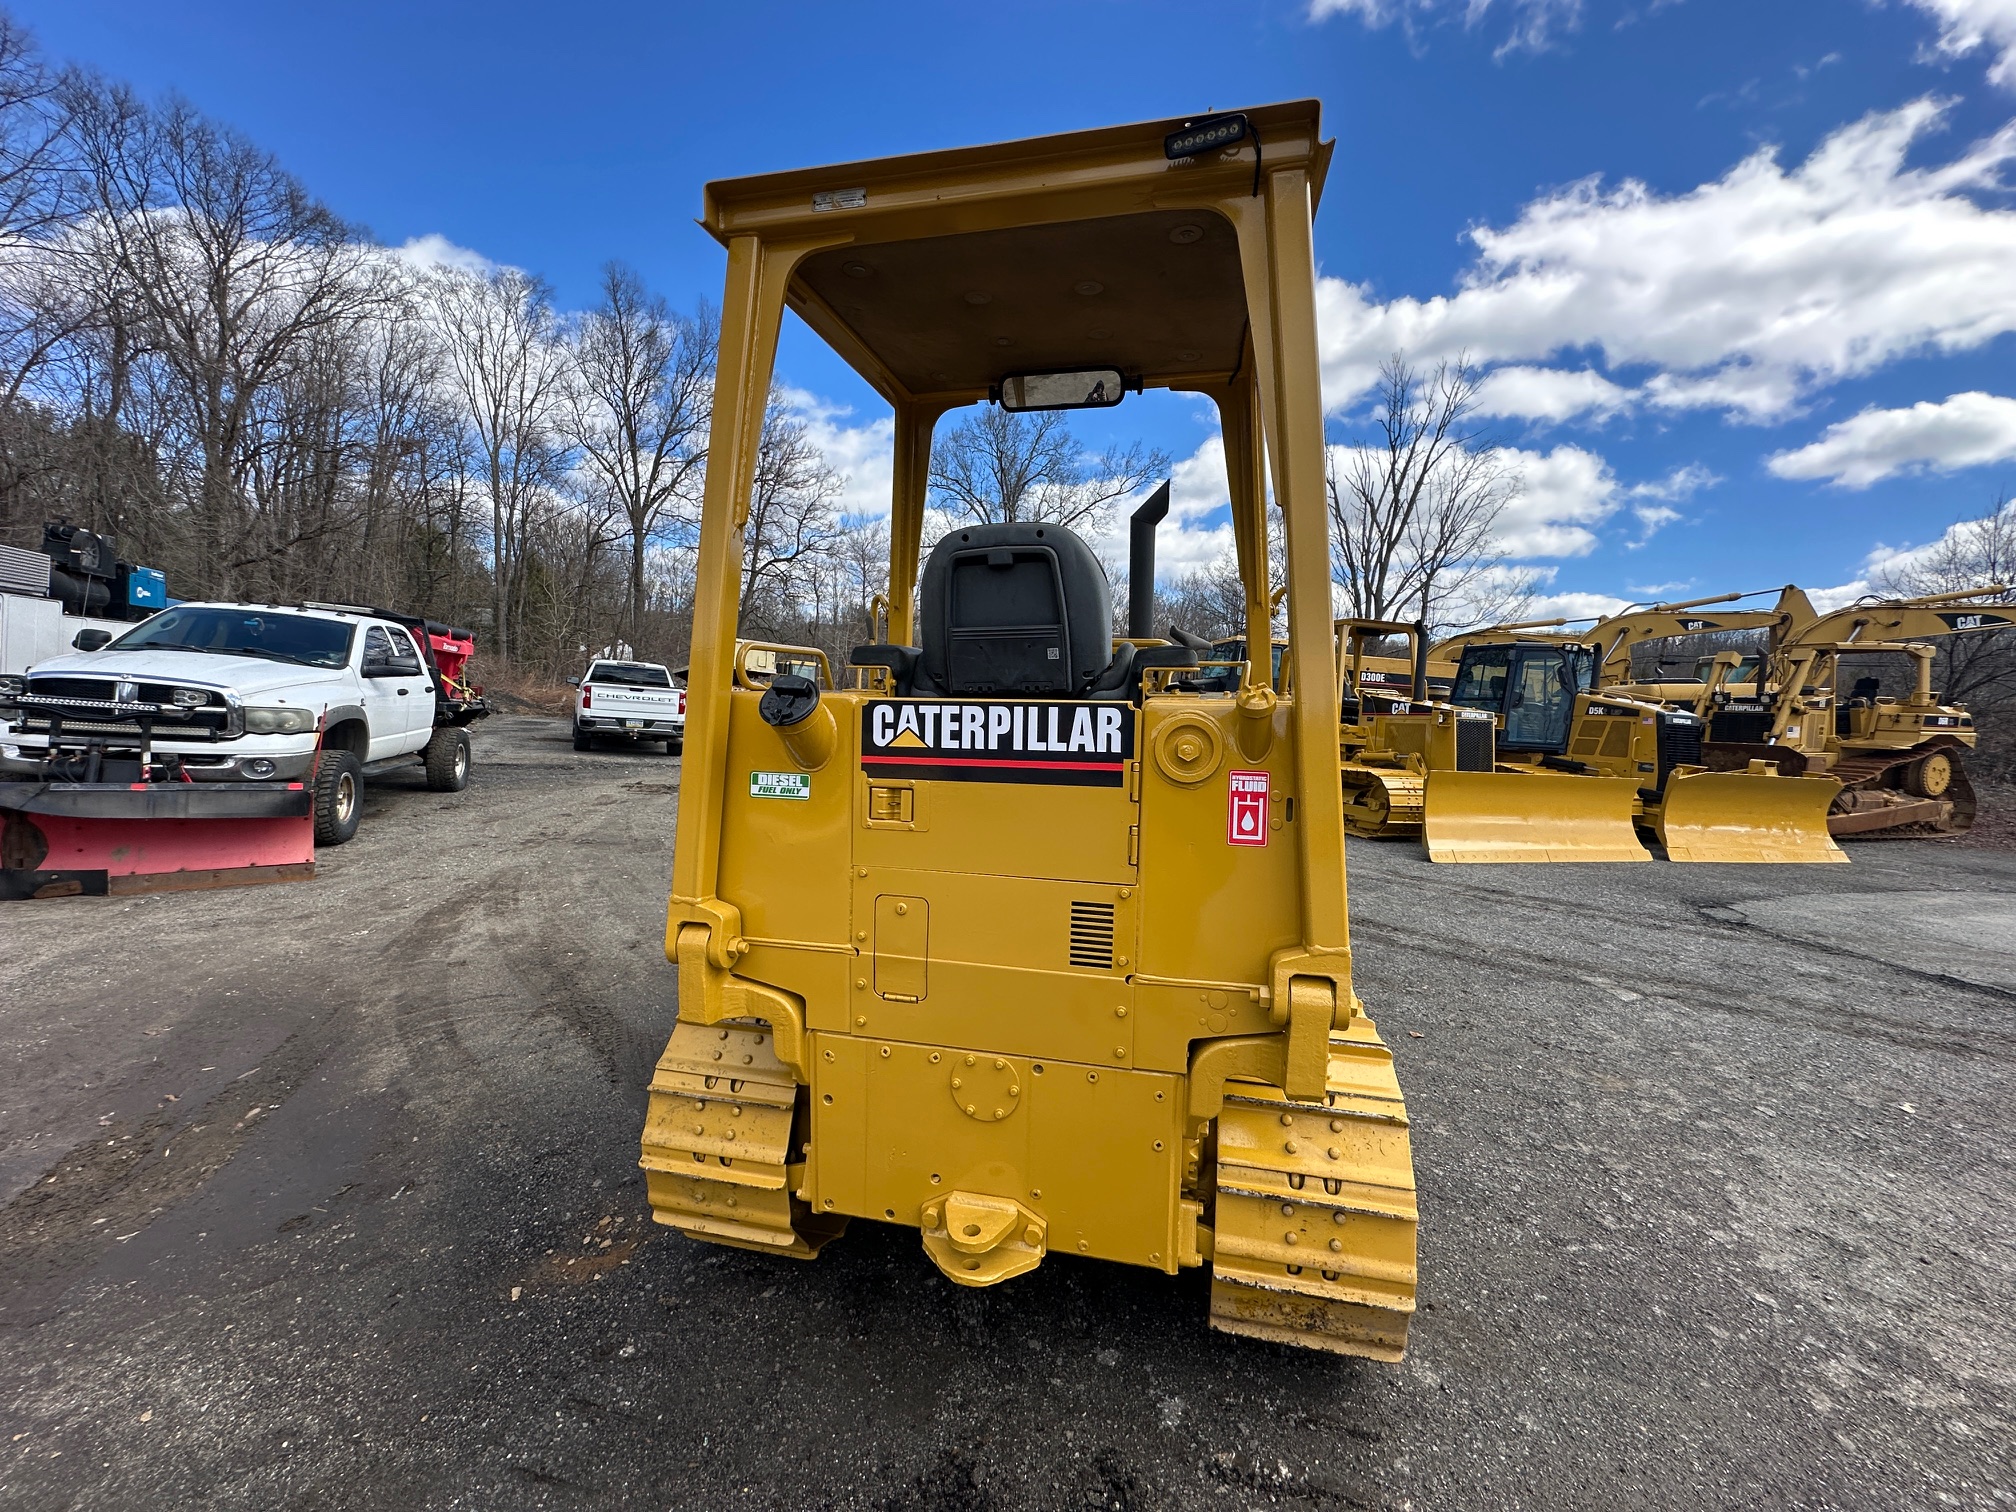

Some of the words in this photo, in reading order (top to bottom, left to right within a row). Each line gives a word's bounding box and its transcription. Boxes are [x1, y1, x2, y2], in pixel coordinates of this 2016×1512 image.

[1688, 621, 1703, 630] CAT
[1957, 615, 1982, 630] CAT
[1361, 672, 1385, 682] D300E
[597, 693, 674, 703] CHEVROLET
[1391, 703, 1412, 715] CAT
[873, 704, 1122, 753] CATERPILLAR
[758, 774, 803, 787] DIESEL
[1231, 780, 1267, 793] FLUID
[758, 786, 777, 794] FUEL
[780, 787, 802, 795] ONLY
